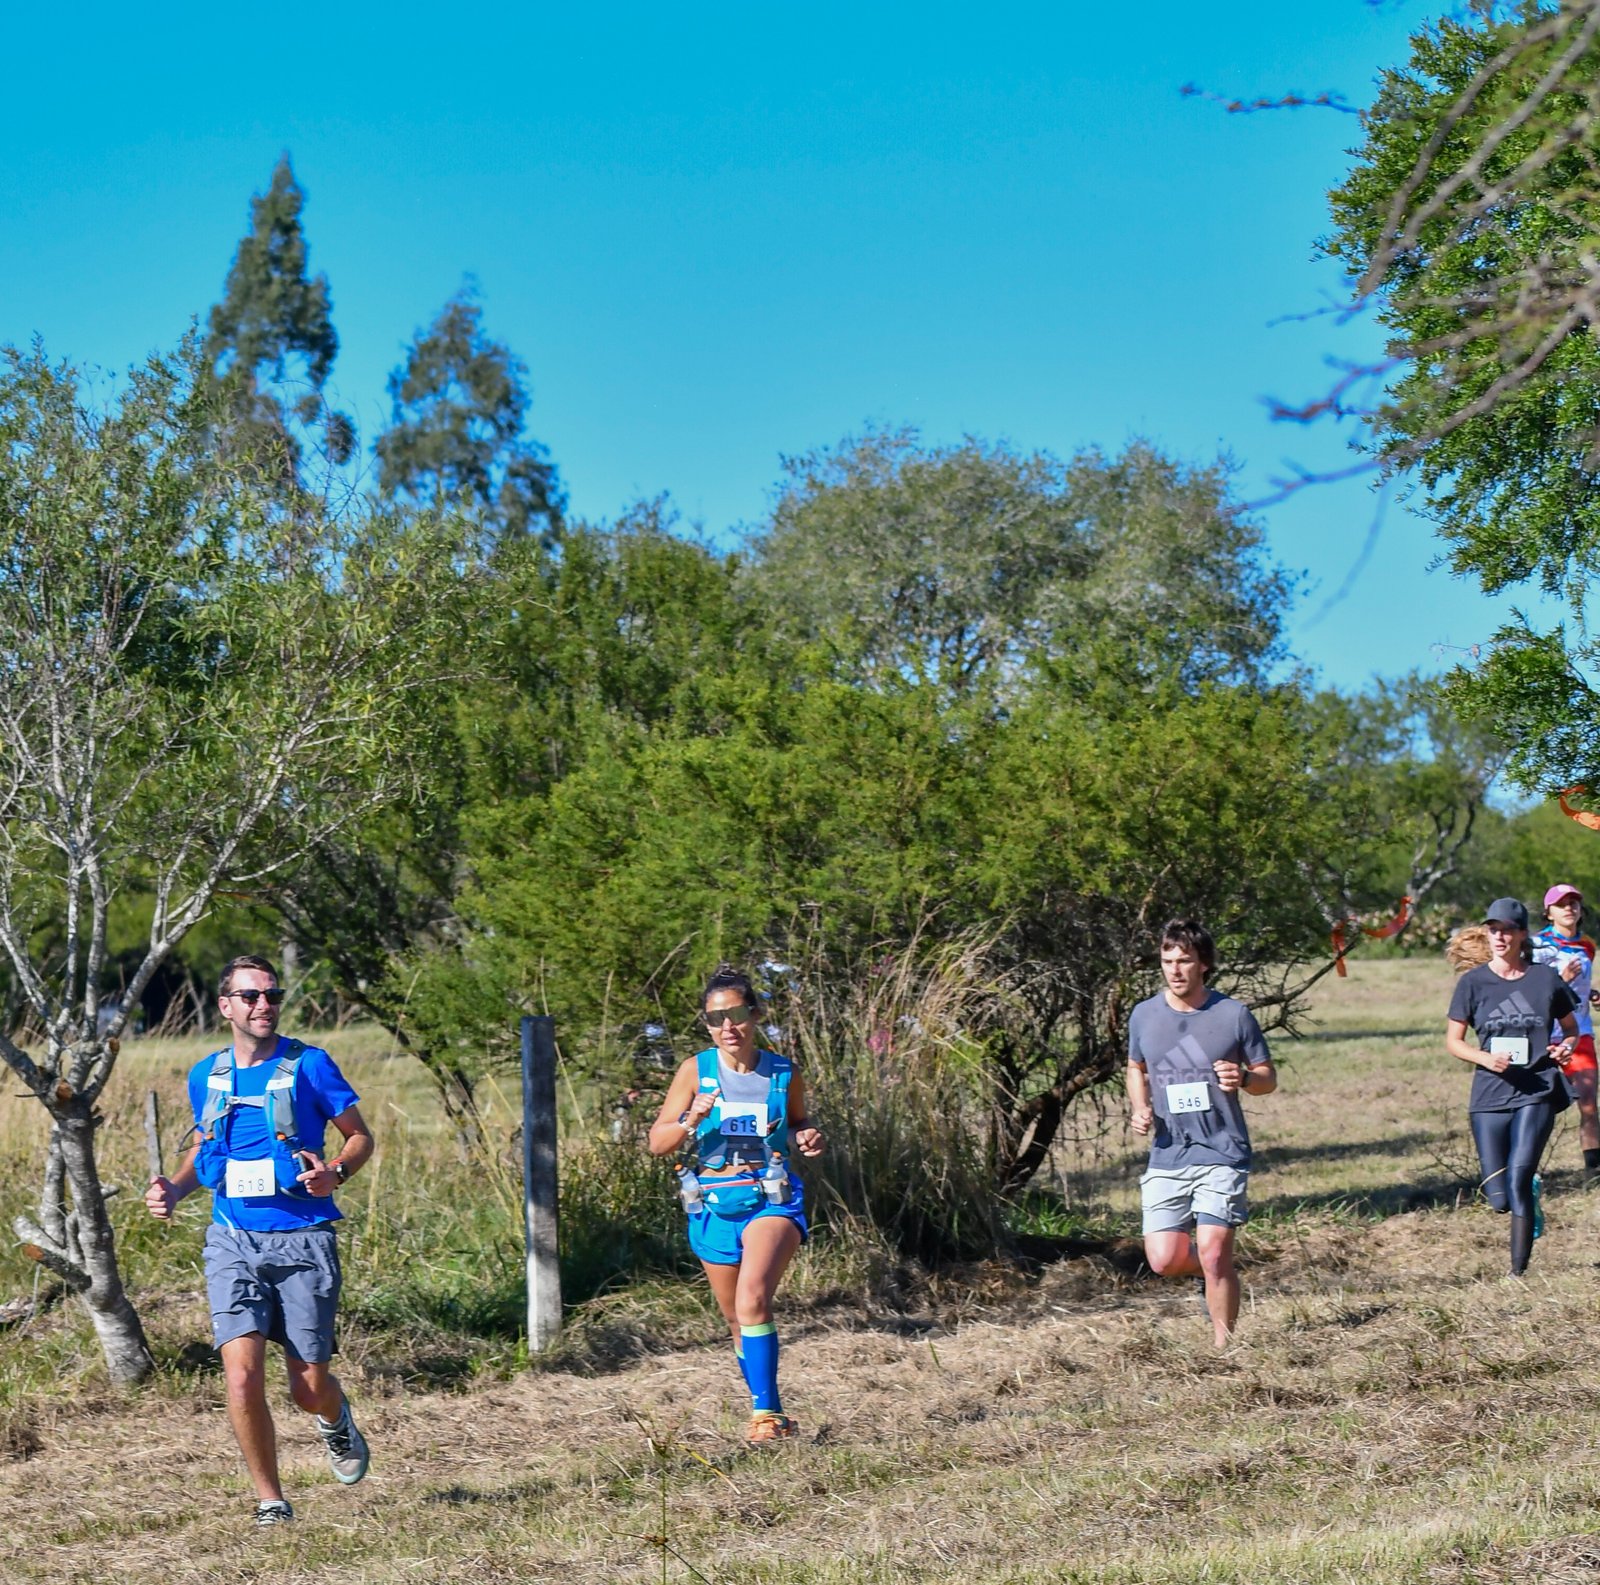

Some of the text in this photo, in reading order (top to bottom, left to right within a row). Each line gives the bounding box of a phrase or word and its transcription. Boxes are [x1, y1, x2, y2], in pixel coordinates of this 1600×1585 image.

[1178, 1096, 1202, 1110] 546
[730, 1118, 758, 1133] 619
[237, 1178, 265, 1193] 618
